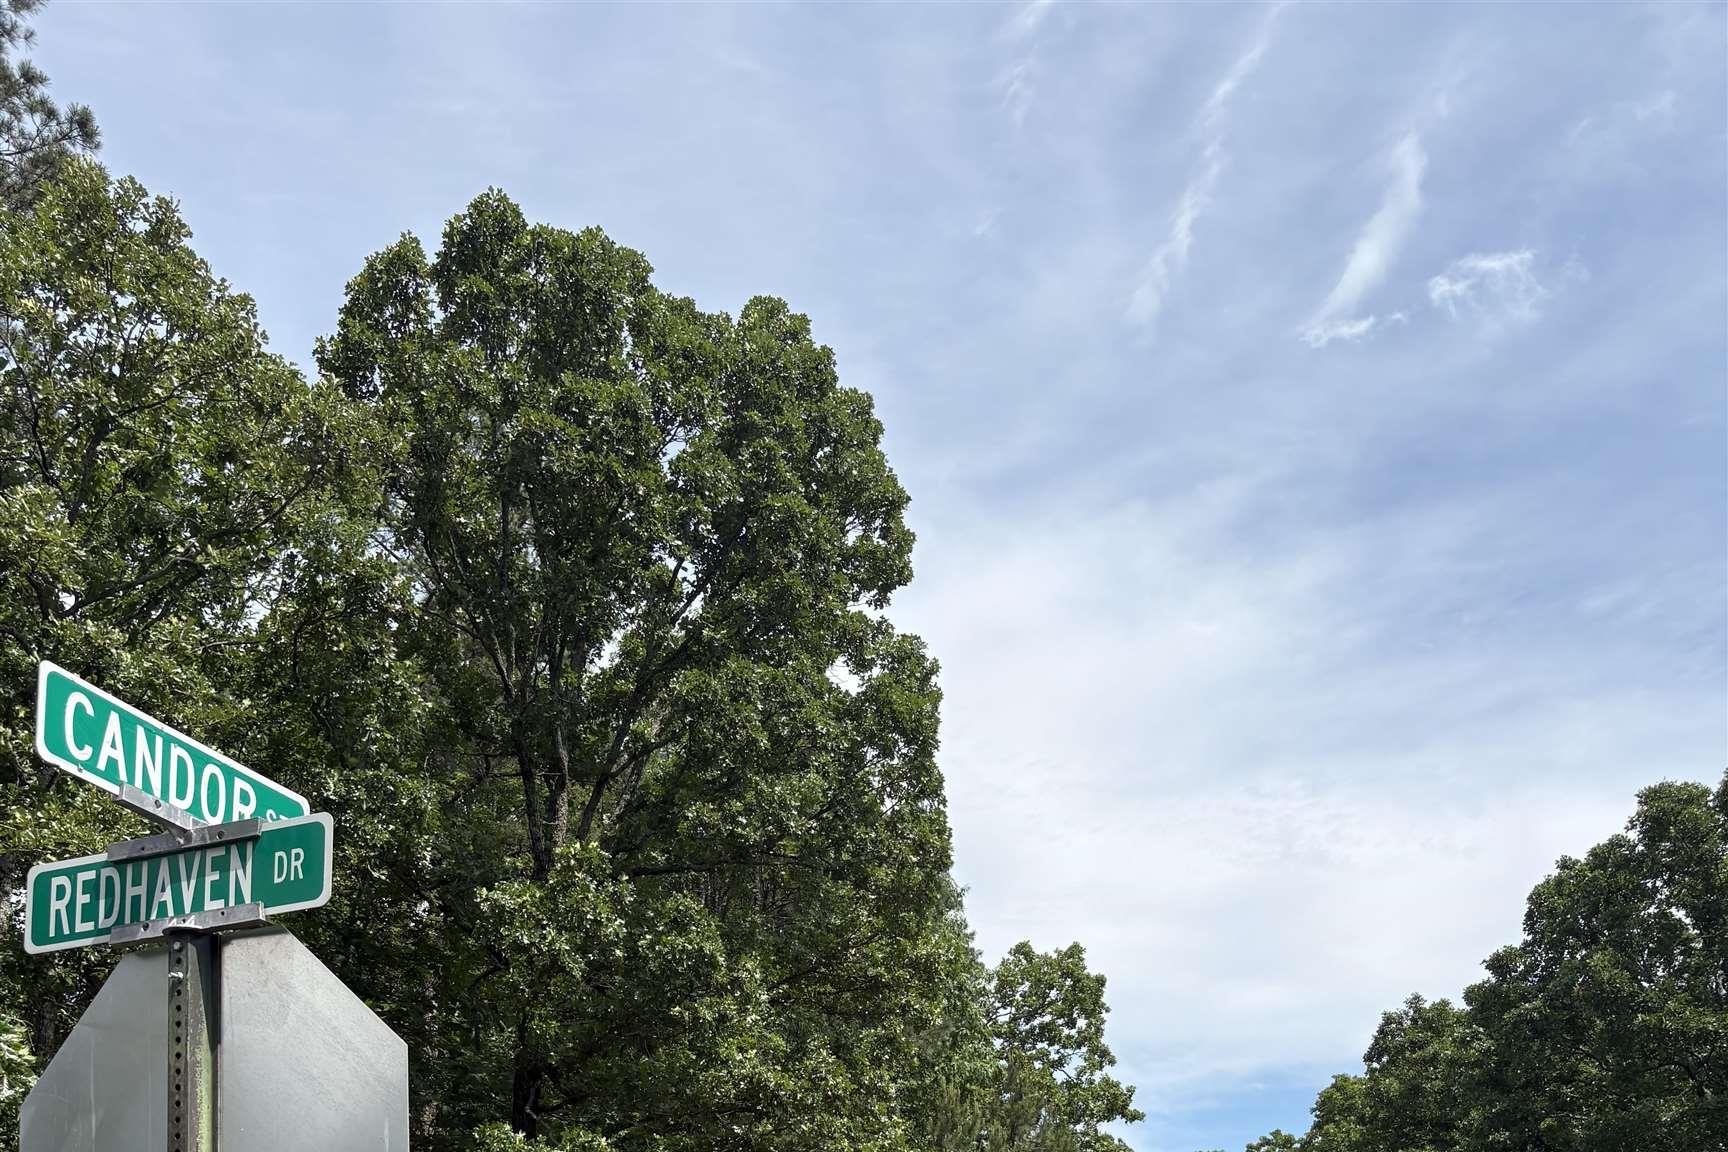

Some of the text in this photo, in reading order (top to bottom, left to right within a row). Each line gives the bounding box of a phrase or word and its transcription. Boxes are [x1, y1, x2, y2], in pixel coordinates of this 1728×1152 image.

[64, 691, 257, 826] CANDOR
[48, 841, 305, 937] REDHAVEN DR
